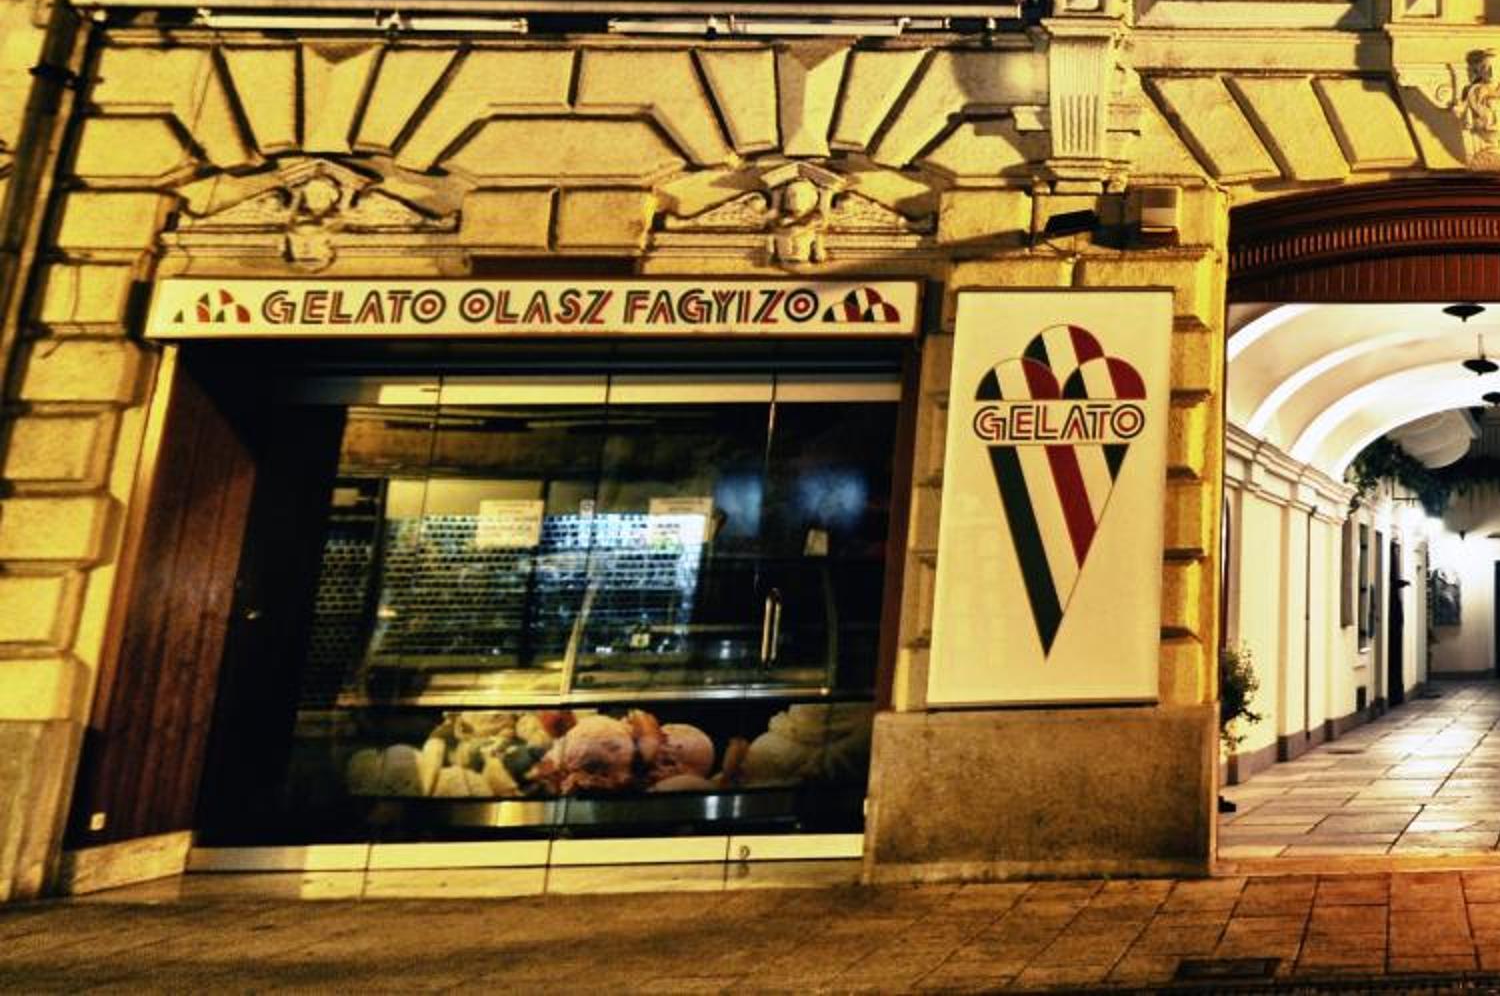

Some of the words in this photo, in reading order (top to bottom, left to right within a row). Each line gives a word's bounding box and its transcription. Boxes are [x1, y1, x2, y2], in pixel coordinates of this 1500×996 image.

[261, 289, 447, 325] GELATO
[458, 288, 613, 325] OLASZ
[623, 288, 820, 324] FAGYIZO
[973, 404, 1145, 441] GELATO
